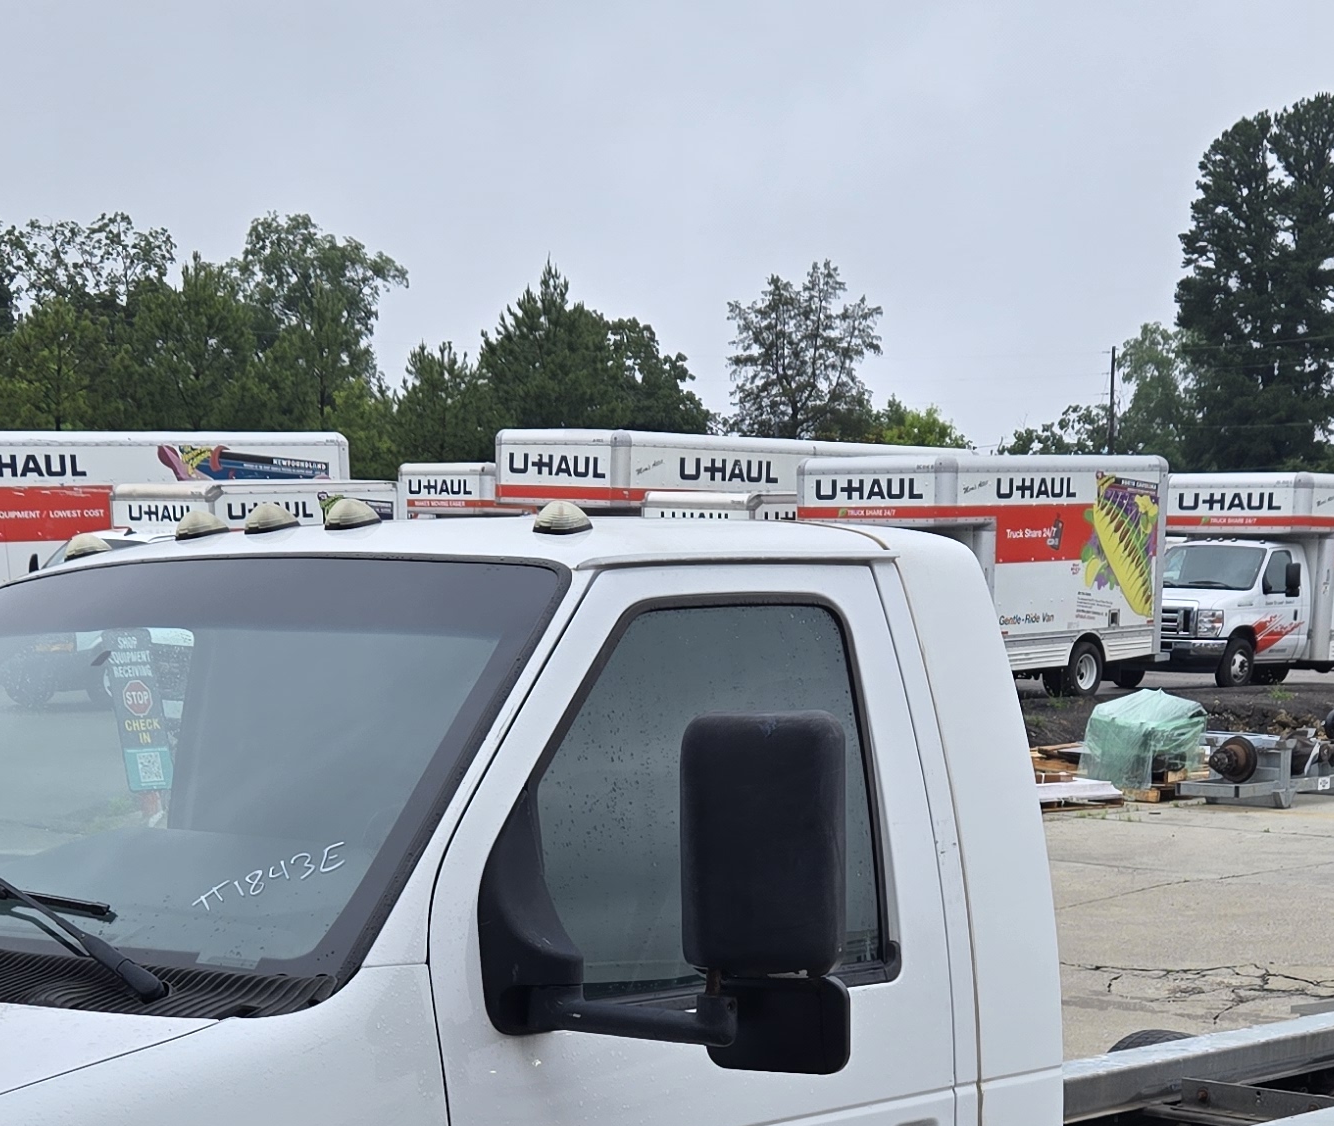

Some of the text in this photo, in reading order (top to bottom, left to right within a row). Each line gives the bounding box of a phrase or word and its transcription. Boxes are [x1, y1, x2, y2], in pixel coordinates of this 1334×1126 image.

[508, 452, 606, 479] U-HAUL
[679, 457, 779, 483] U-HAUL
[408, 479, 472, 495] U-HAUL
[815, 478, 923, 500] U-HAUL
[996, 477, 1077, 499] U-HAUL
[1178, 492, 1282, 511] U-HAUL
[49, 510, 81, 518] LOWEST
[83, 509, 104, 517] COST
[128, 504, 190, 522] U-HAU
[1006, 528, 1024, 538] Truck
[1024, 527, 1042, 537] Share
[1042, 613, 1055, 624] Van
[117, 636, 137, 649] SHOP
[125, 692, 149, 705] STOP
[124, 718, 161, 731] CHECK
[139, 733, 152, 744] IN
